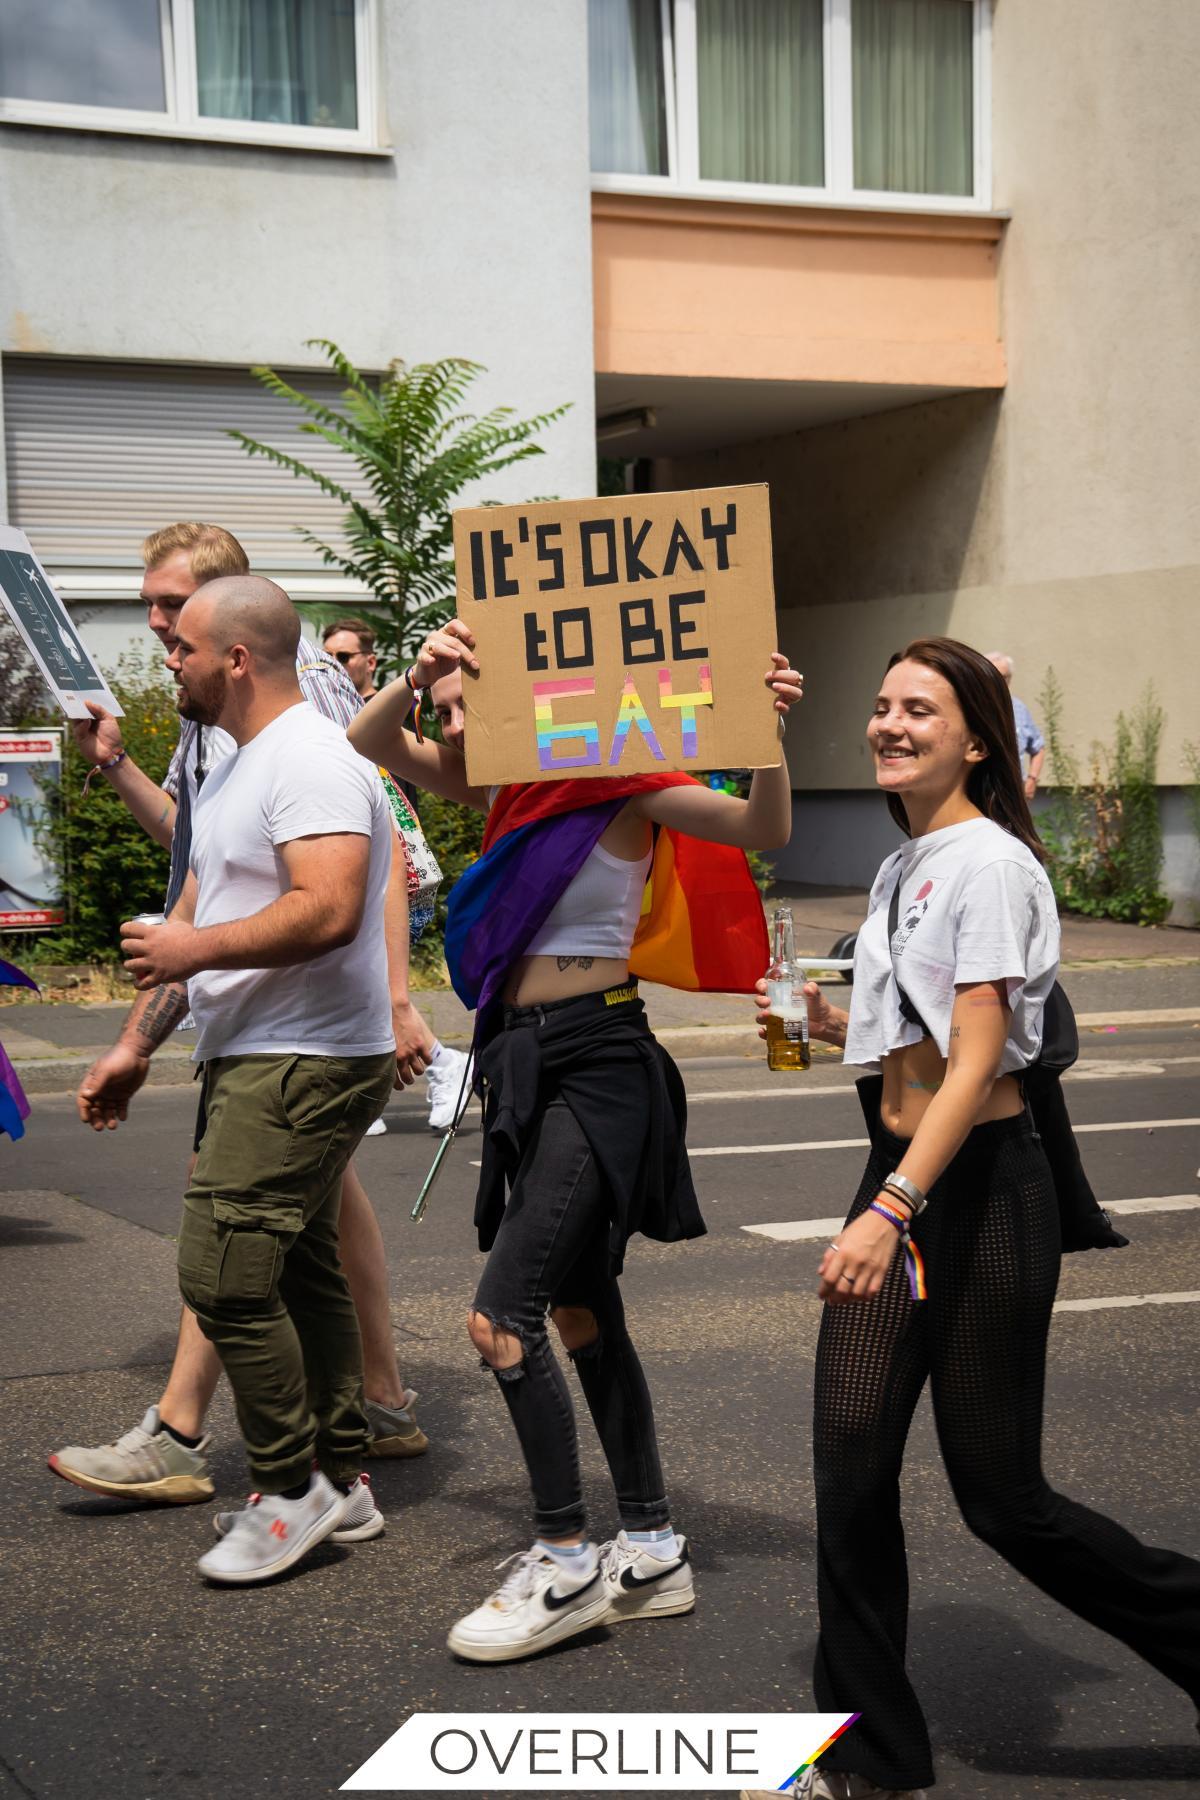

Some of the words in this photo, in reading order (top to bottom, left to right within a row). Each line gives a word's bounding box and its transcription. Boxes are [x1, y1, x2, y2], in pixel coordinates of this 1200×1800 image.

[580, 504, 737, 587] OKAY
[619, 590, 708, 665] BE
[533, 664, 713, 771] GAY
